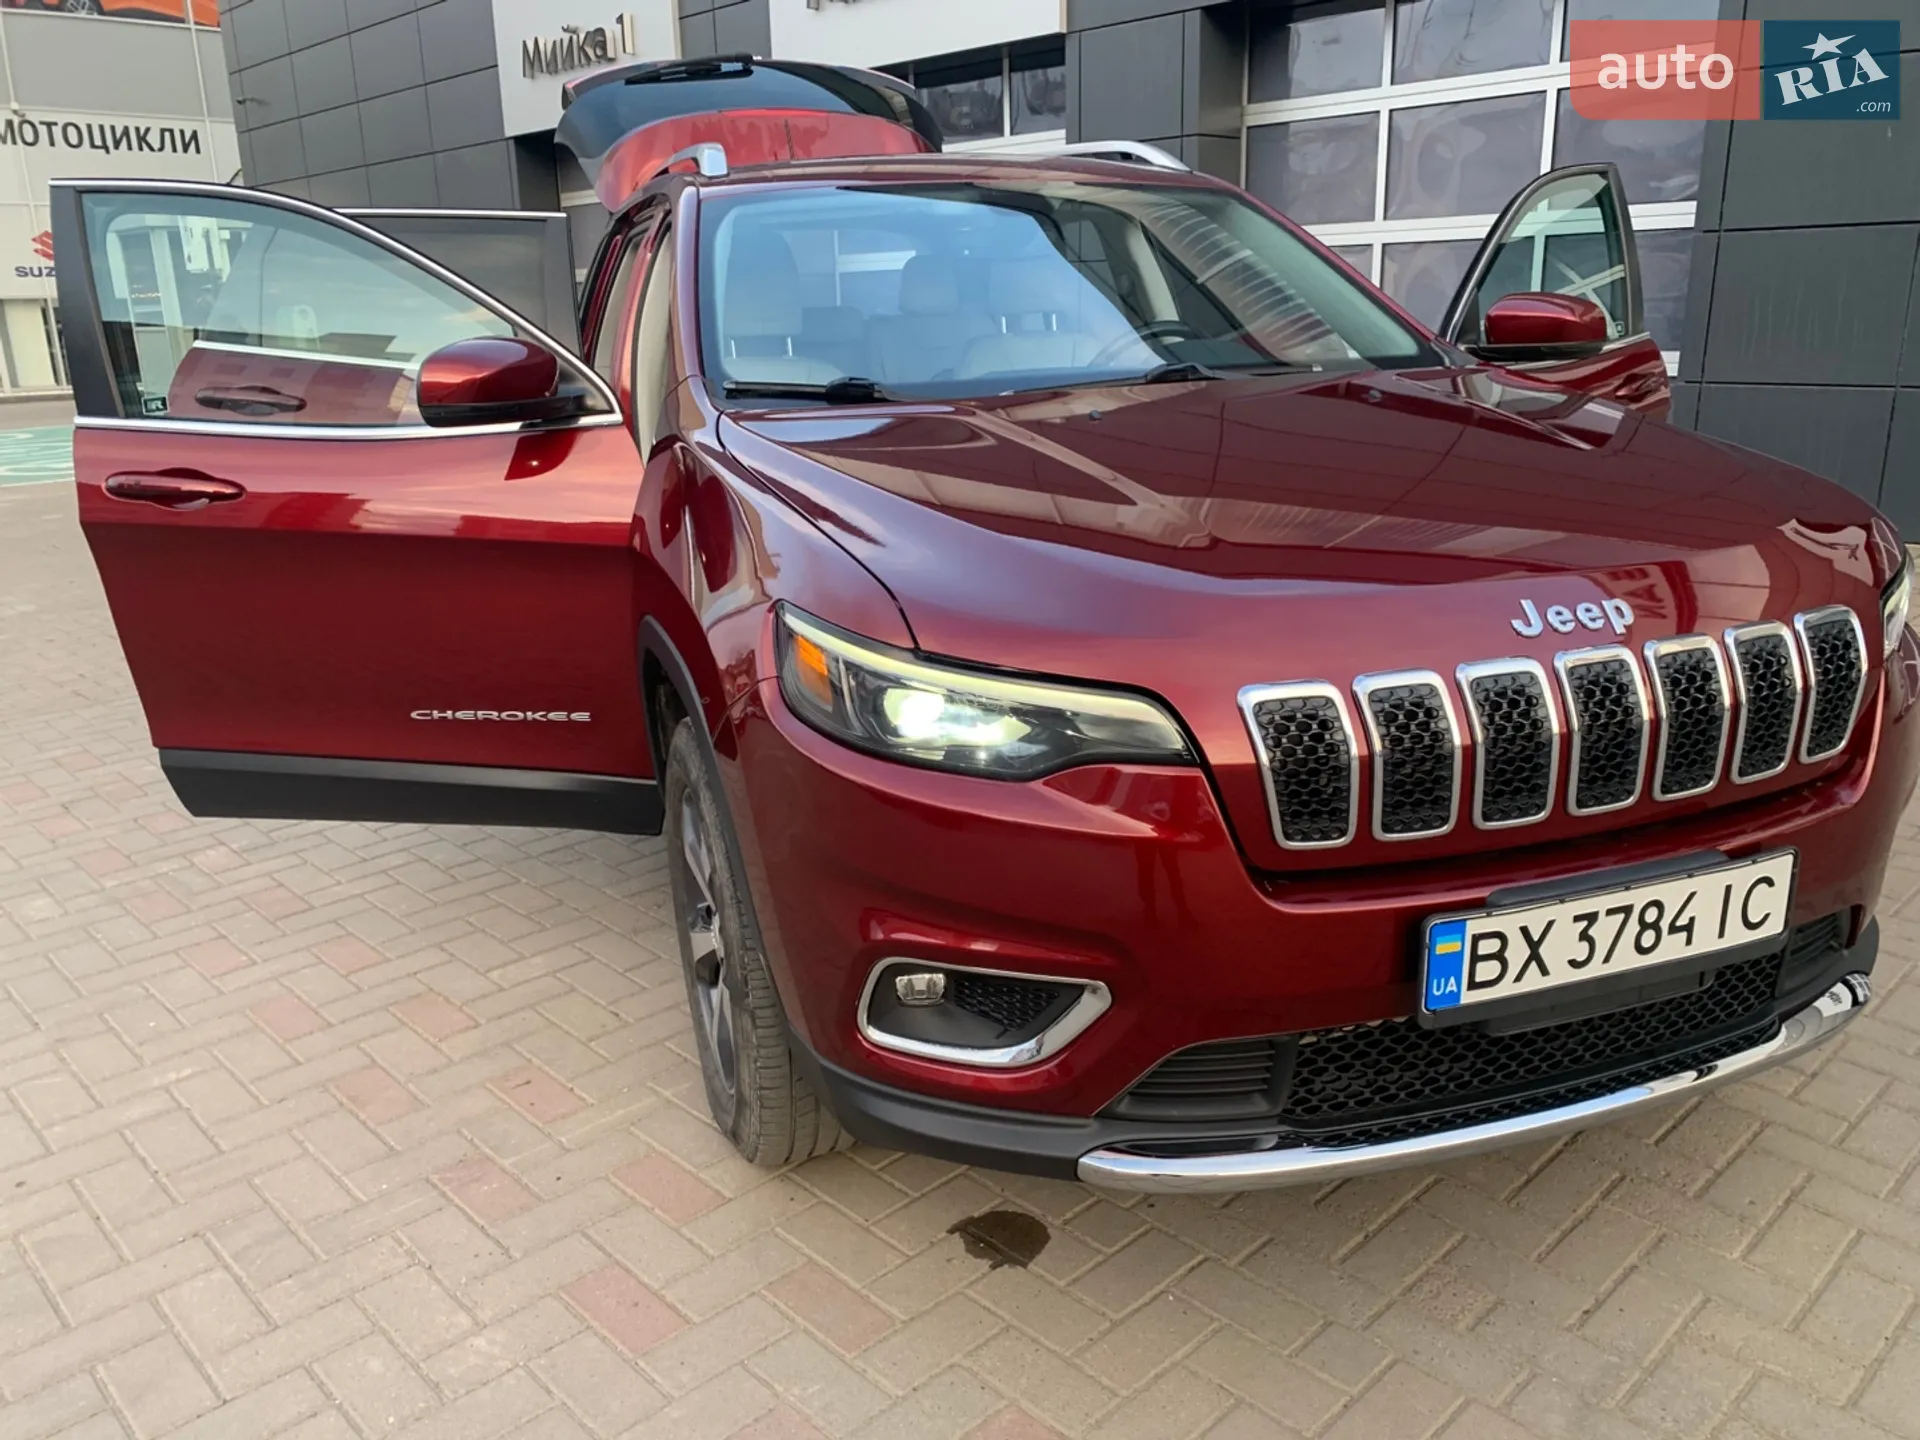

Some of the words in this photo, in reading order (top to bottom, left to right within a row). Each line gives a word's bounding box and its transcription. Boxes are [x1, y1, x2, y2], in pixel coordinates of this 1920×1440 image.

[522, 24, 617, 79] Мийка
[615, 12, 635, 55] 1
[0, 117, 201, 155] МОТОЦИКЛИ
[1510, 598, 1635, 638] Jeep
[410, 710, 591, 722] CHEROKEE
[1466, 919, 1556, 992] BX
[1567, 891, 1697, 970] 3784
[1717, 875, 1775, 939] IC
[1432, 975, 1458, 997] UA
